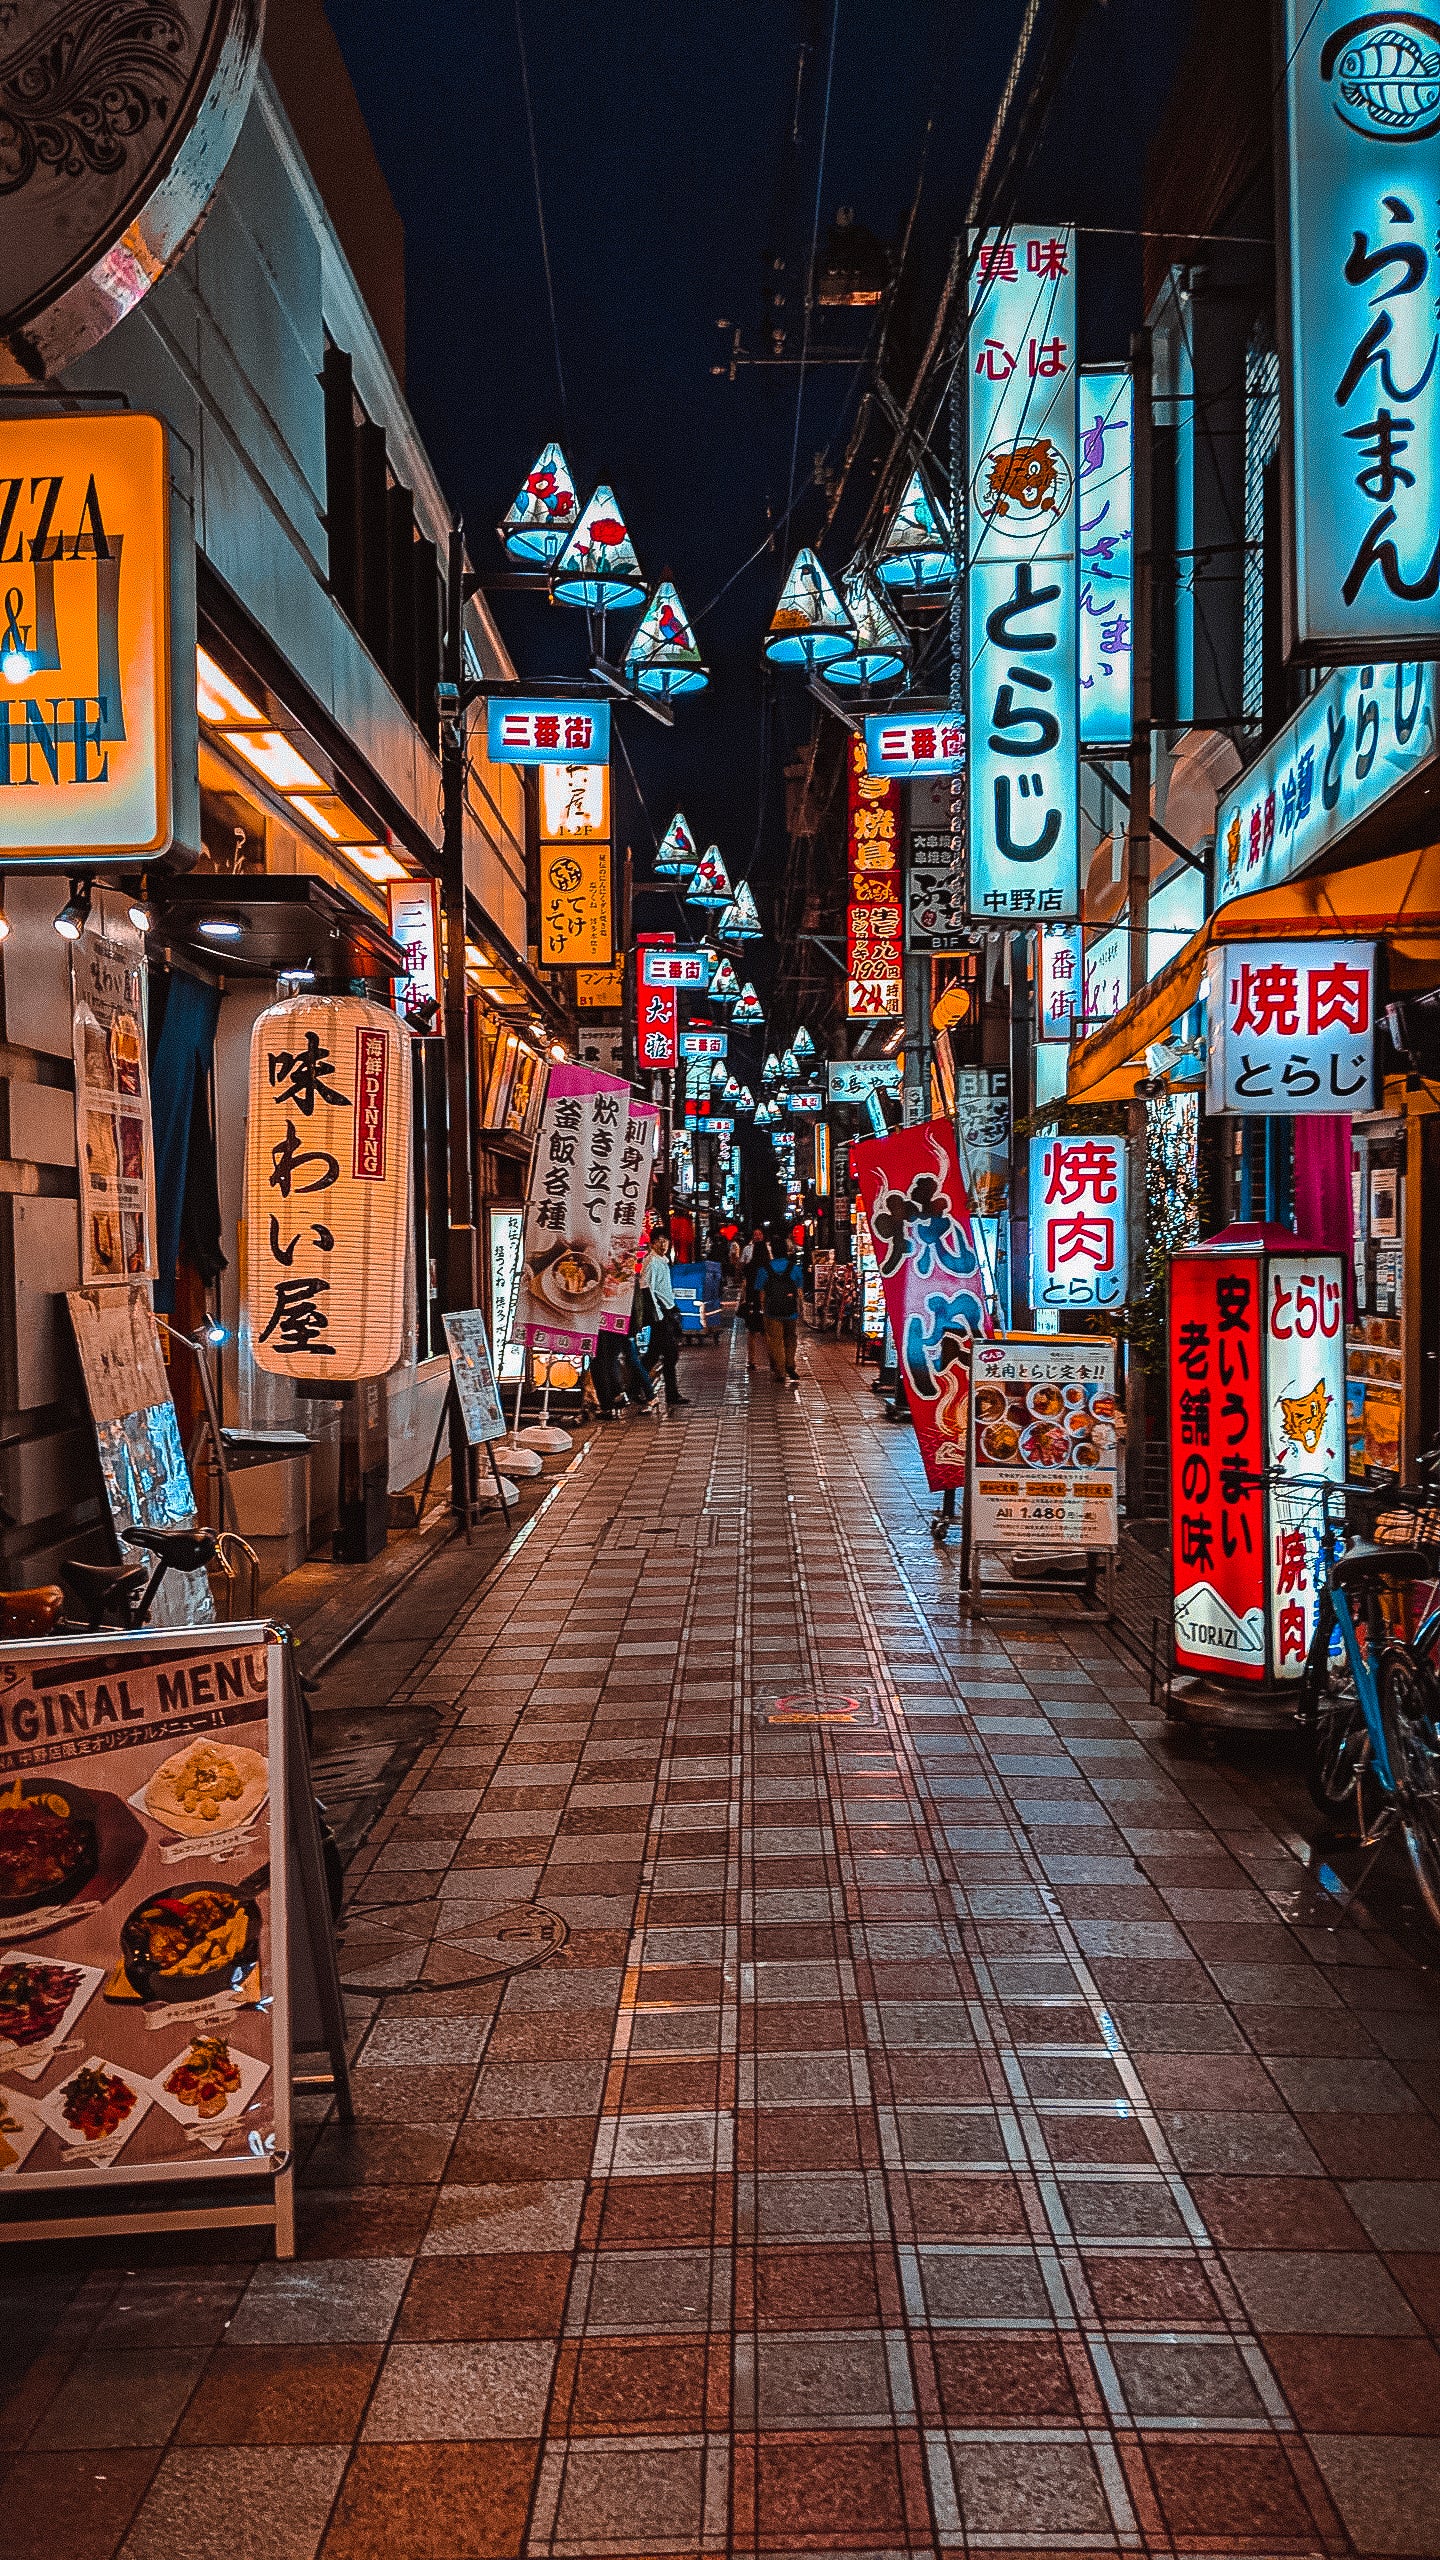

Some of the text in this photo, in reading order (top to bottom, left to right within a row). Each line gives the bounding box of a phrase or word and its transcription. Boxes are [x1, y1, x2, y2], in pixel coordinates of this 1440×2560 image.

[1335, 196, 1440, 606] らんまん
[503, 715, 592, 749] 三番街
[985, 562, 1061, 862] とらじ
[983, 888, 1063, 913] 中野店
[651, 961, 702, 980] 三番街
[853, 982, 883, 1013] 24
[1230, 962, 1371, 1036] 焼肉
[362, 1037, 385, 1174] 海鮮DINING
[1234, 1053, 1368, 1098] とらじ
[258, 1031, 354, 1356] 味わい屋
[537, 1097, 582, 1232] 釜飯各種
[583, 1092, 619, 1224] 炊き立て
[614, 1118, 648, 1226] 刺身七種
[1043, 1141, 1117, 1273] 焼肉
[1042, 1277, 1119, 1303] とらじ
[1270, 1274, 1341, 1341] とらじ
[1177, 1319, 1215, 1575] 老舗の味
[1215, 1275, 1253, 1559] 安いうまい
[1188, 1621, 1238, 1650] TORAZI
[1276, 1526, 1308, 1667] 焼肉
[157, 1654, 268, 1713] MENU
